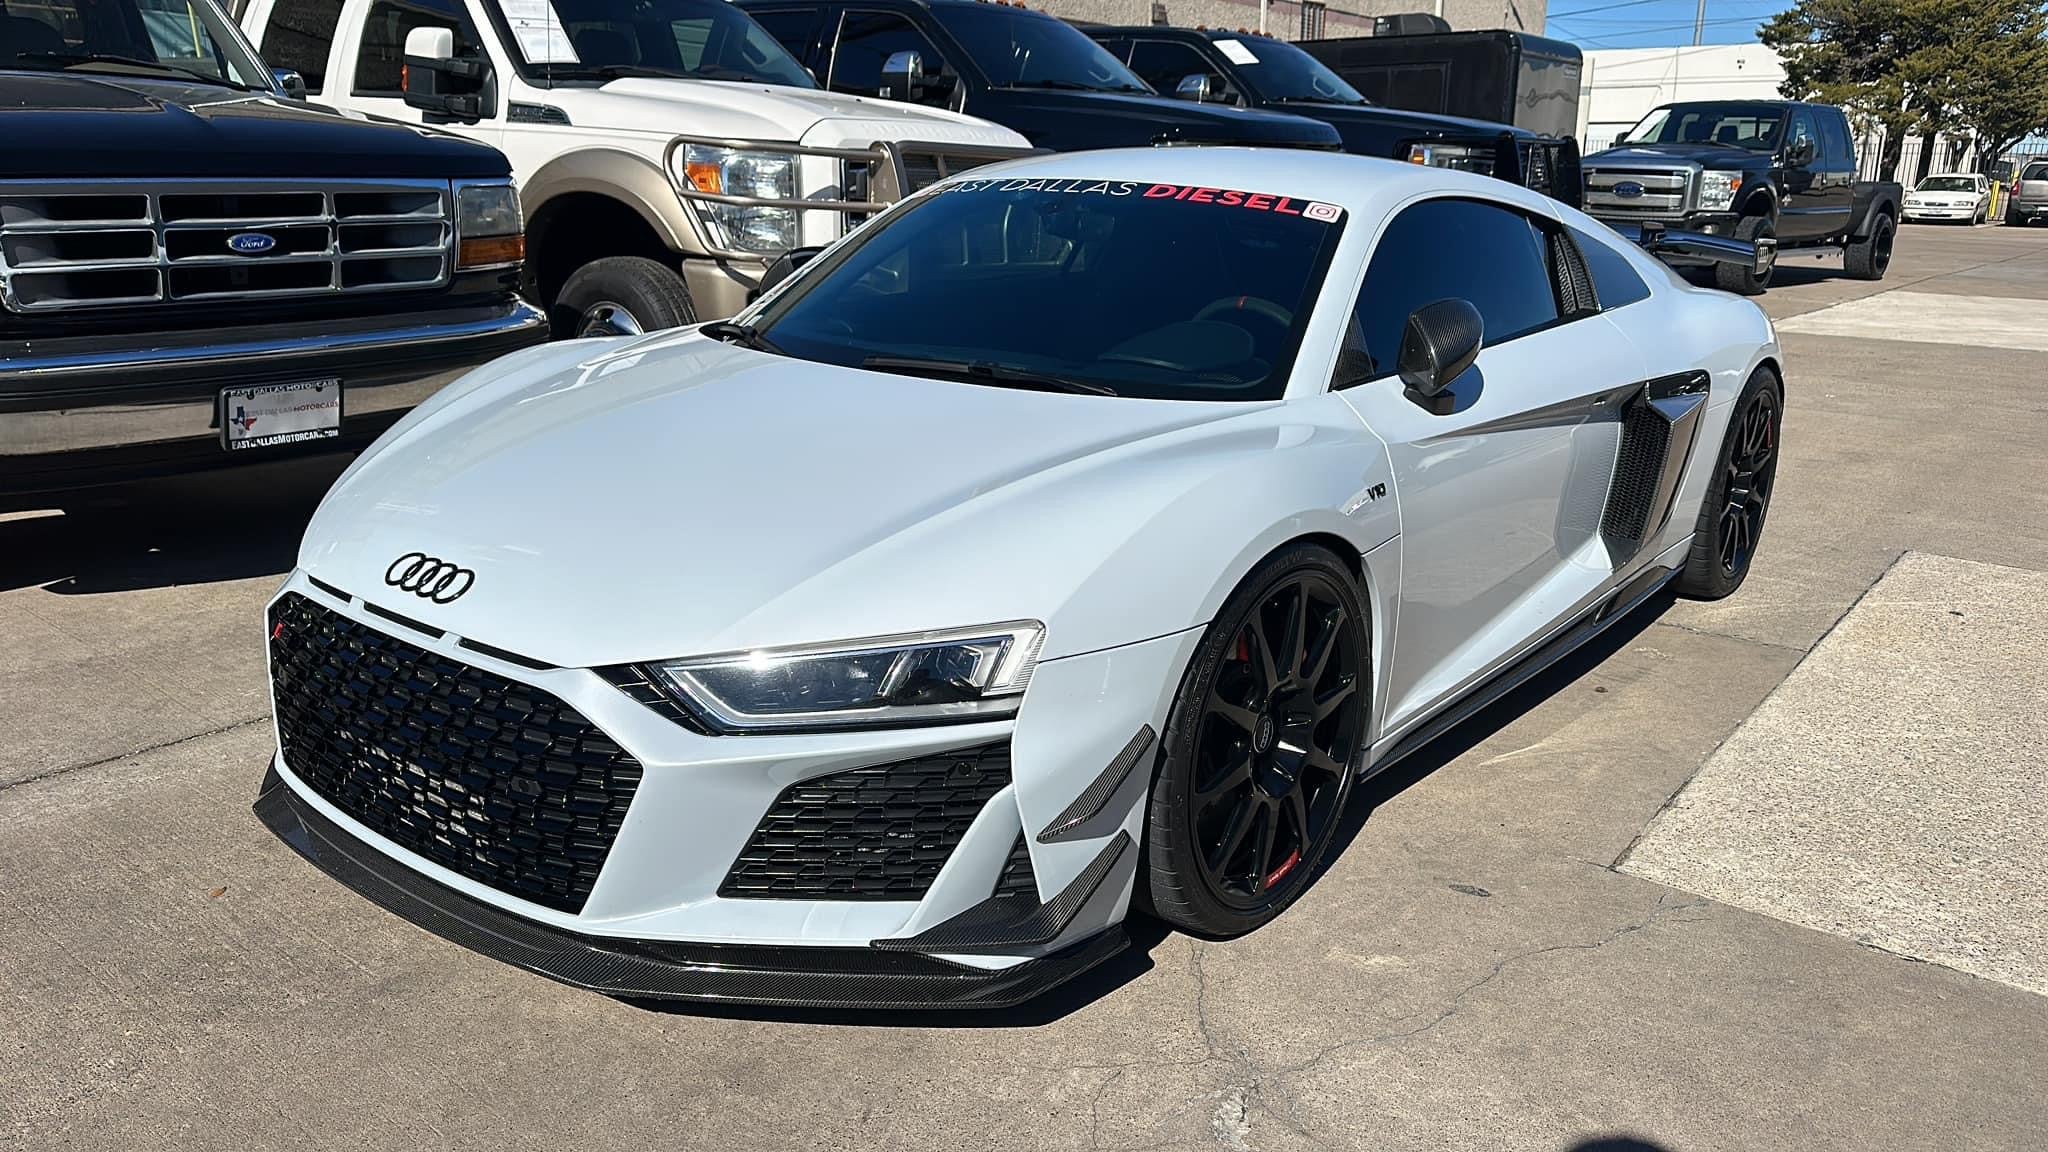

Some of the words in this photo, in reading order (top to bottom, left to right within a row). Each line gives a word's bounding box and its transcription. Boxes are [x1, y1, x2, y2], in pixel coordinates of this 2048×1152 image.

[1000, 179, 1138, 196] DALLAS
[1143, 184, 1300, 216] DIESEL
[240, 237, 266, 248] Ford
[293, 401, 339, 412] MOTORCARS
[1366, 482, 1387, 501] V10
